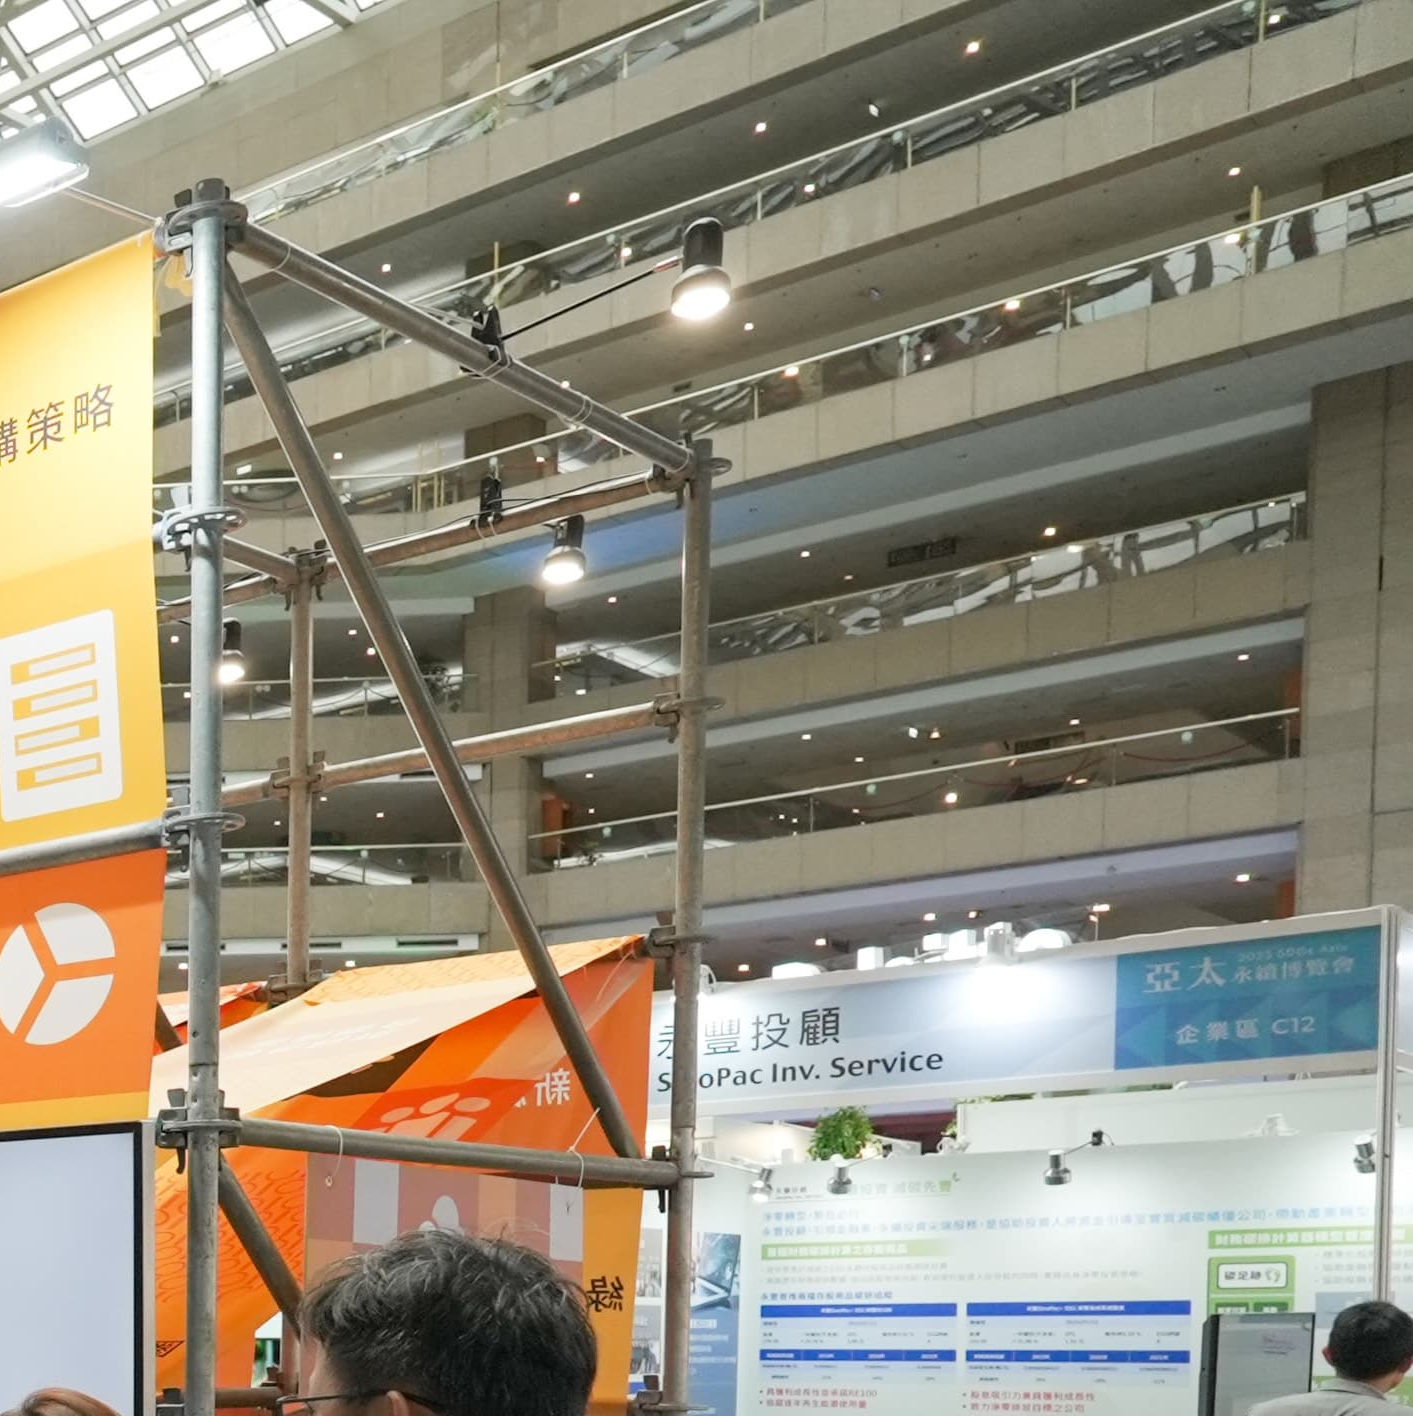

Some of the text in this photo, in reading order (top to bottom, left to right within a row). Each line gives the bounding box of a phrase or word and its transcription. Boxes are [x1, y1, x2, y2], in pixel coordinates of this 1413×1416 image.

[1143, 956, 1226, 994] 亞太
[1176, 1015, 1316, 1045] 企業區 C12
[657, 1051, 943, 1093] SoPac Inv. Service
